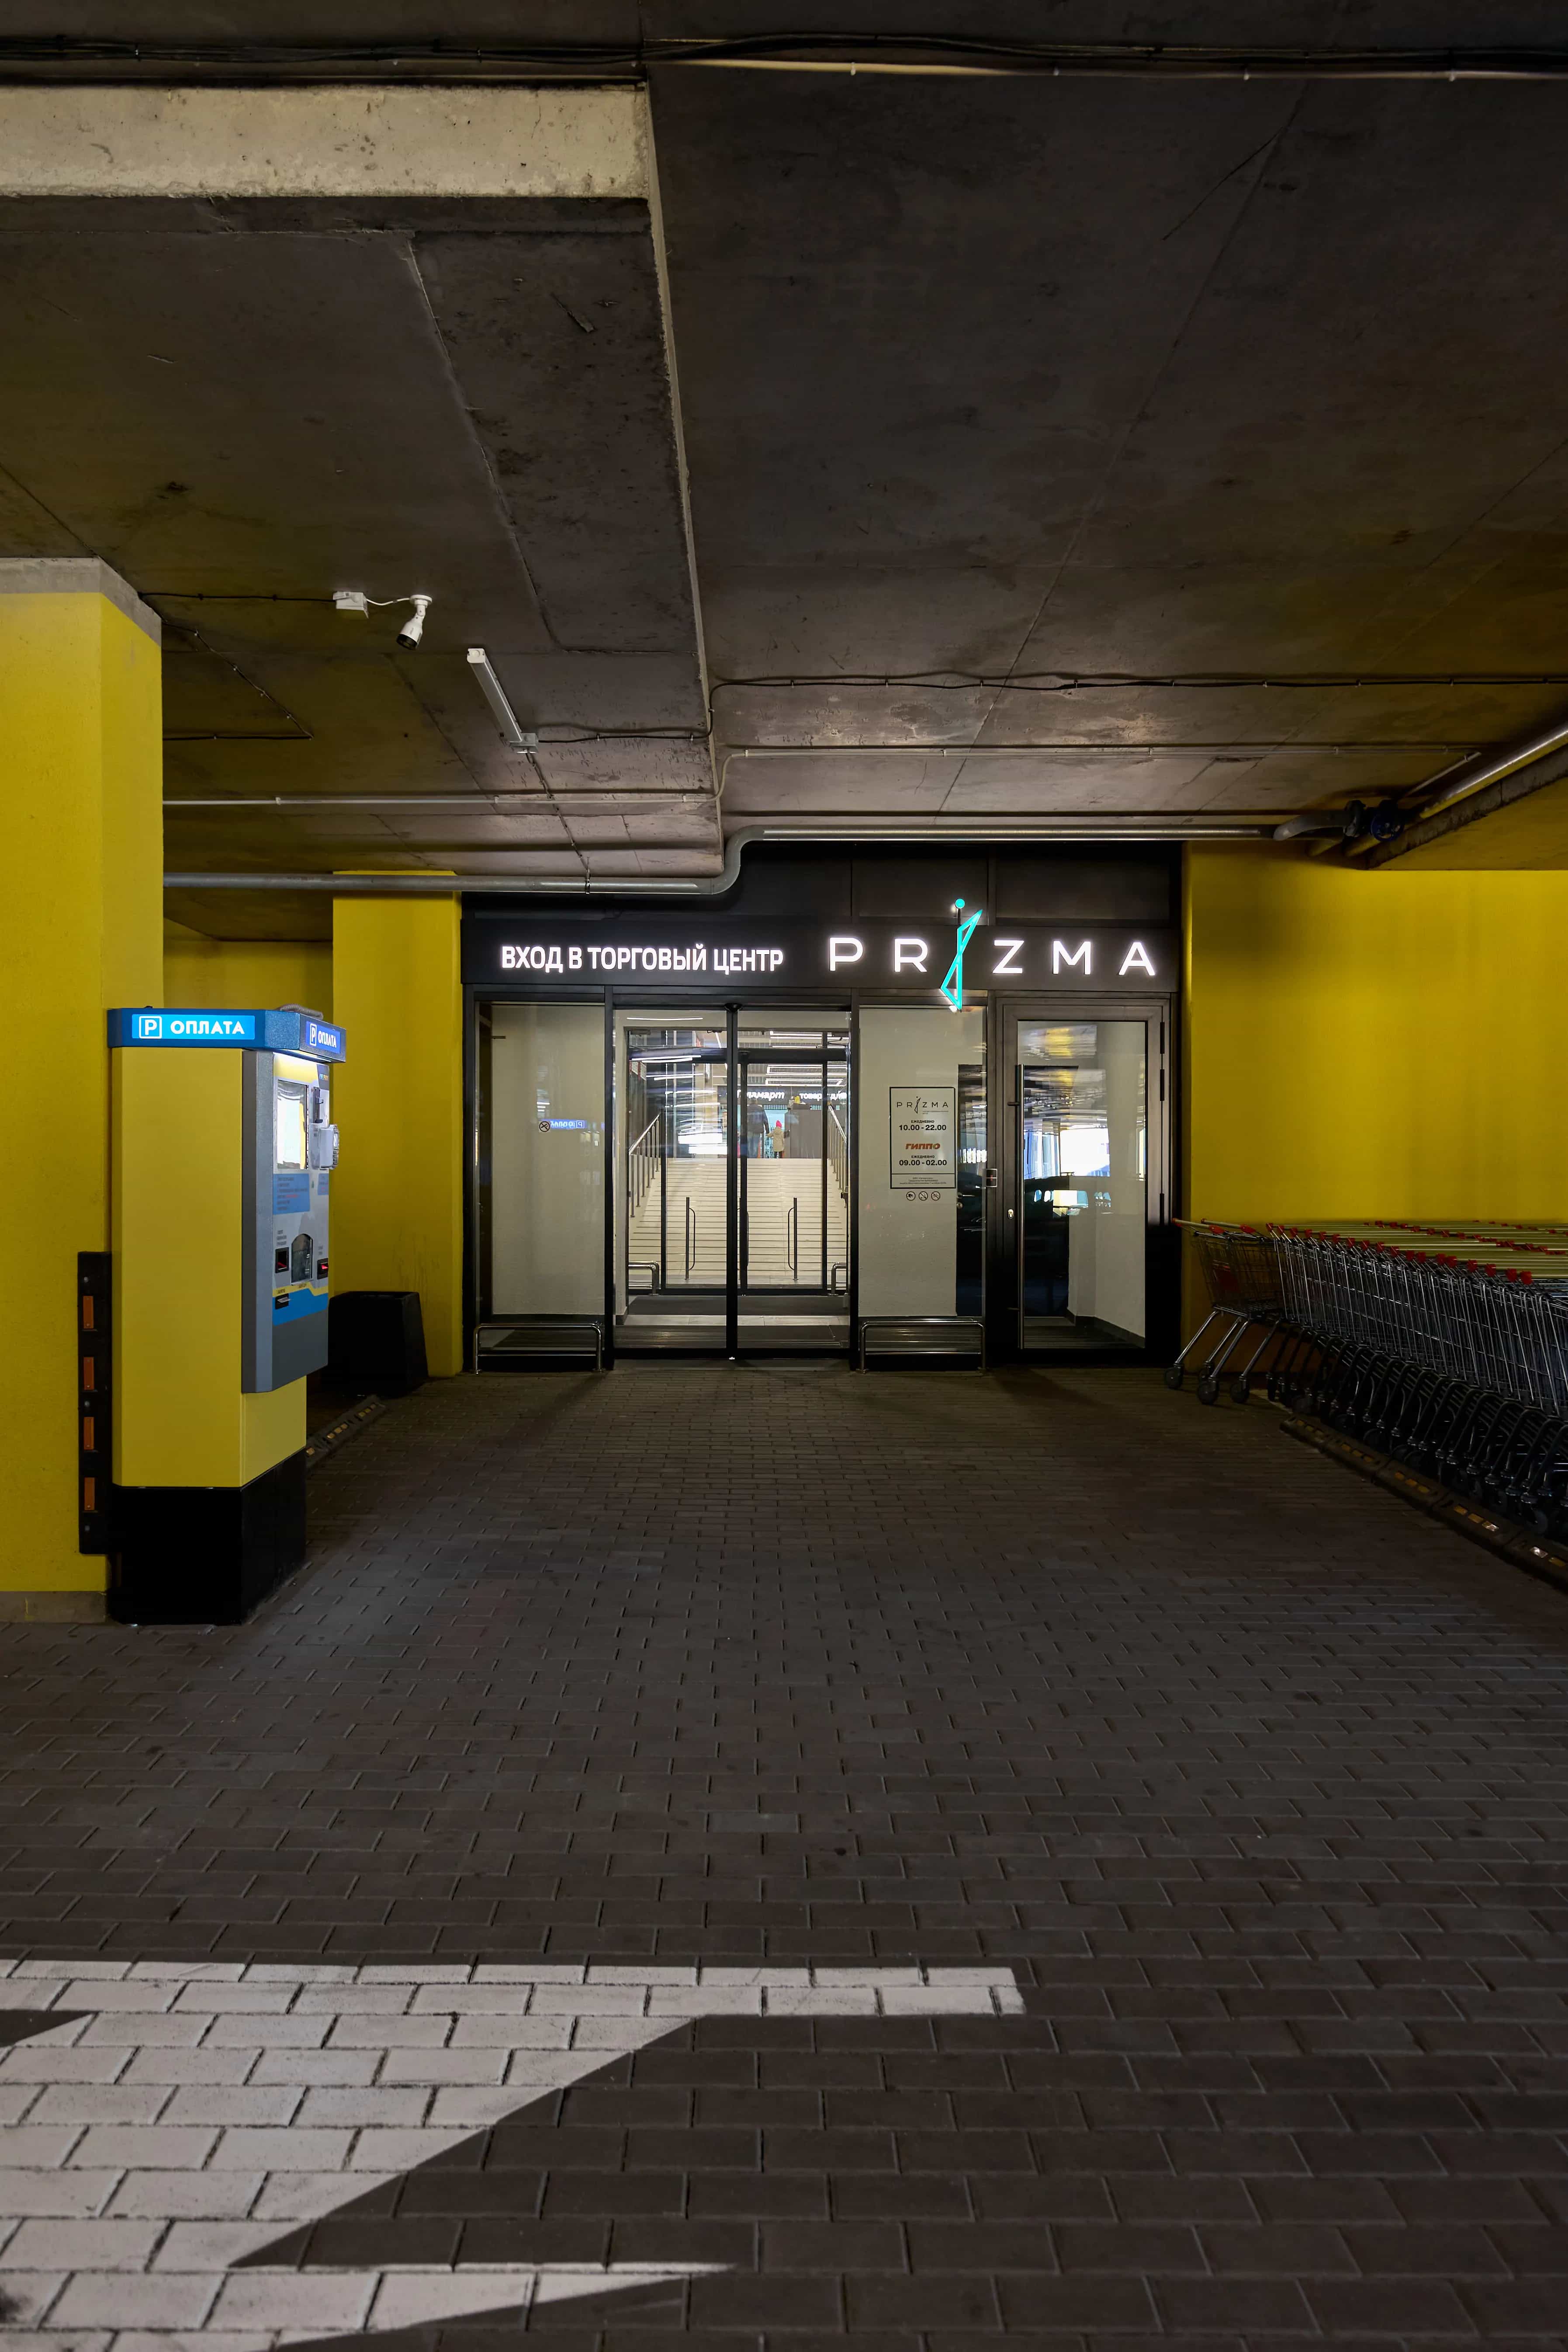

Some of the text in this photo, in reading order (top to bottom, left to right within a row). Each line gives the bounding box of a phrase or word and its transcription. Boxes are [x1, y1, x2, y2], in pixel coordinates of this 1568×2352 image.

[502, 944, 784, 975] ВХОД В ТОРГОВЫЙ ЦЕНТР
[170, 1020, 245, 1034] ОПЛАТА
[318, 1030, 337, 1048] ОПЛАТА
